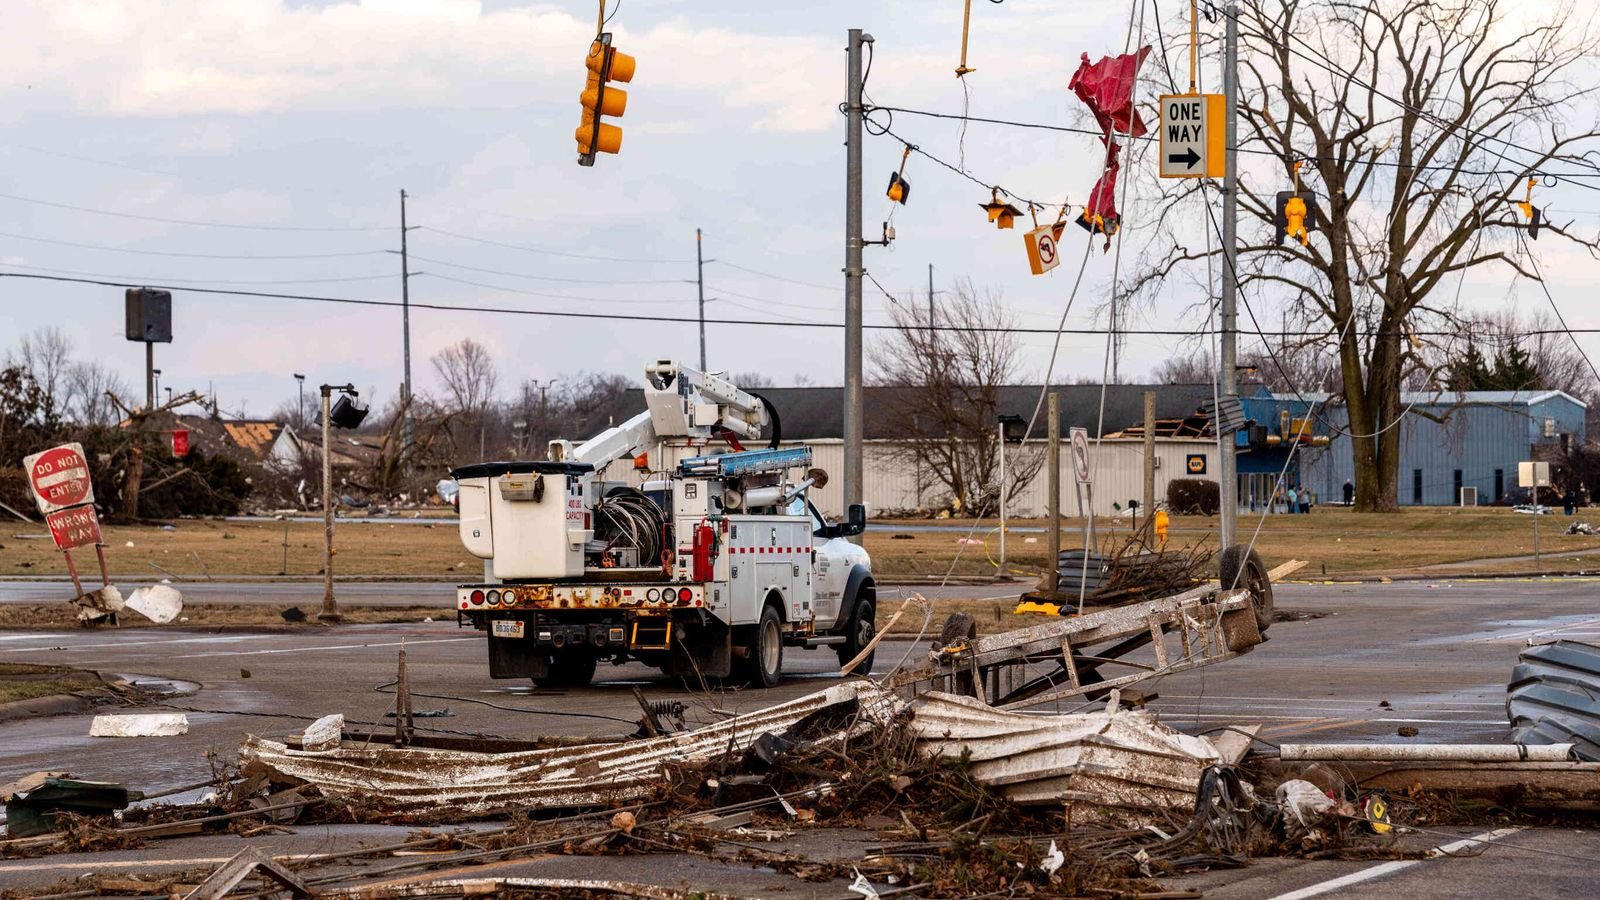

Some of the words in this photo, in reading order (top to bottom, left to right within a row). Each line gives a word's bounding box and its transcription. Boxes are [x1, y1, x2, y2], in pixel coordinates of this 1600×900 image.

[1169, 103, 1200, 120] ONE
[1168, 125, 1201, 142] WAY
[37, 463, 52, 475] DO
[57, 455, 79, 468] NOT
[49, 480, 85, 498] ENTER
[52, 511, 96, 530] WRONG
[566, 511, 583, 520] CAPACITY
[68, 527, 93, 542] WAY
